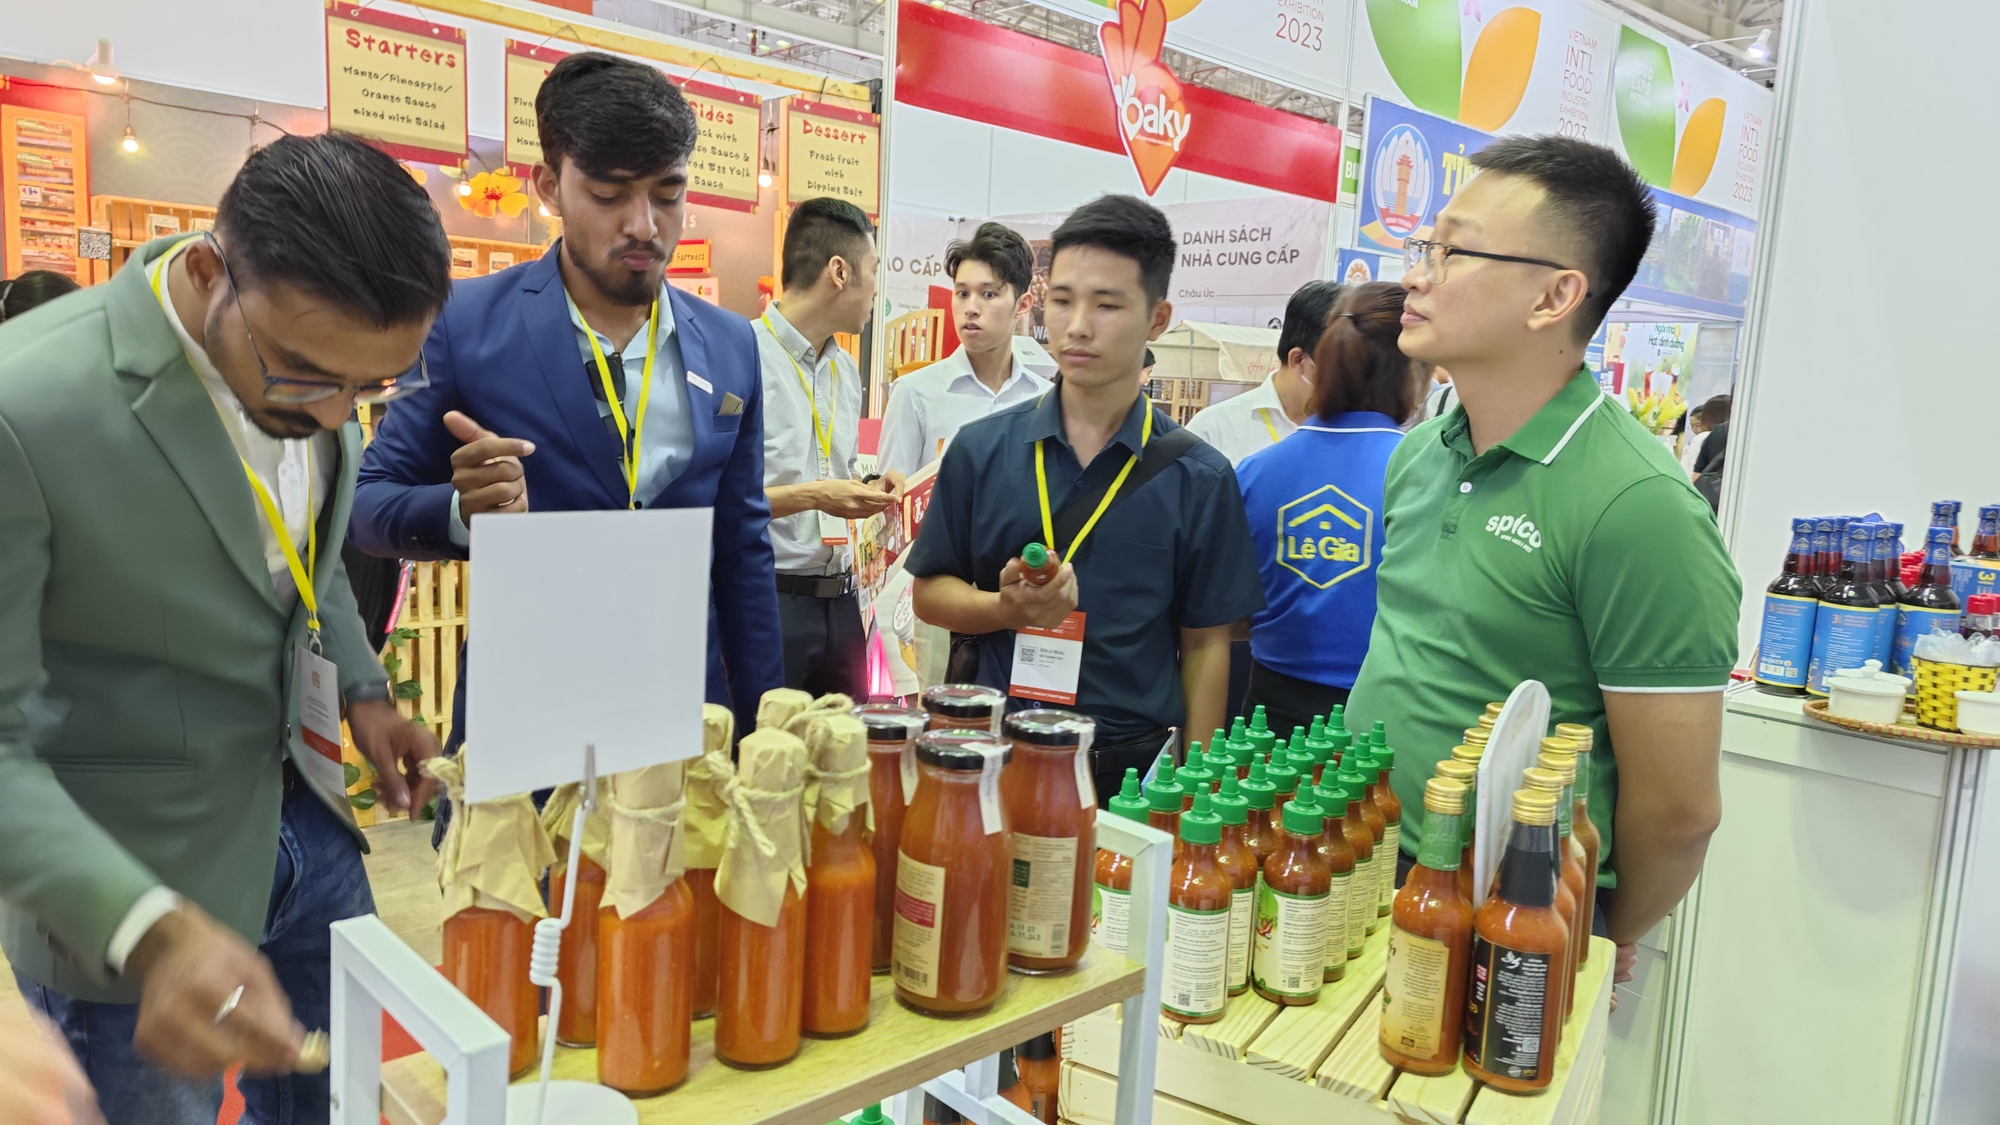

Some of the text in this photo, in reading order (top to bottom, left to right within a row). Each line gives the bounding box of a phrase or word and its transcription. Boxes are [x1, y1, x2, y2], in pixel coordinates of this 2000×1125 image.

[1276, 13, 1323, 51] 2023
[1569, 28, 1597, 50] VIETNAM
[345, 28, 456, 69] Starters
[1563, 69, 1592, 94] FOOD
[361, 88, 437, 109] Orange Sauce
[513, 97, 533, 107] Five
[353, 107, 445, 130] mixed with Salad
[513, 117, 535, 127] Chili
[1558, 117, 1587, 140] 2023
[716, 132, 738, 143] with
[803, 119, 866, 145] Dessert
[711, 146, 739, 160] Sauce
[743, 153, 750, 162] &
[809, 150, 859, 166] Fresh fruit
[1739, 143, 1758, 163] FOOD
[708, 162, 726, 174] Egg
[729, 167, 750, 177] Yolk
[825, 169, 844, 178] with
[694, 176, 724, 189] Sauce
[807, 180, 863, 197] Dipping Salt
[1733, 182, 1754, 203] 2023
[1183, 224, 1272, 245] DANH SÁCH
[909, 254, 942, 277] CẤP
[1181, 243, 1300, 267] NHÀ CUNG CẤP
[1178, 289, 1202, 298] Châu
[1287, 535, 1360, 563] Lê Gia
